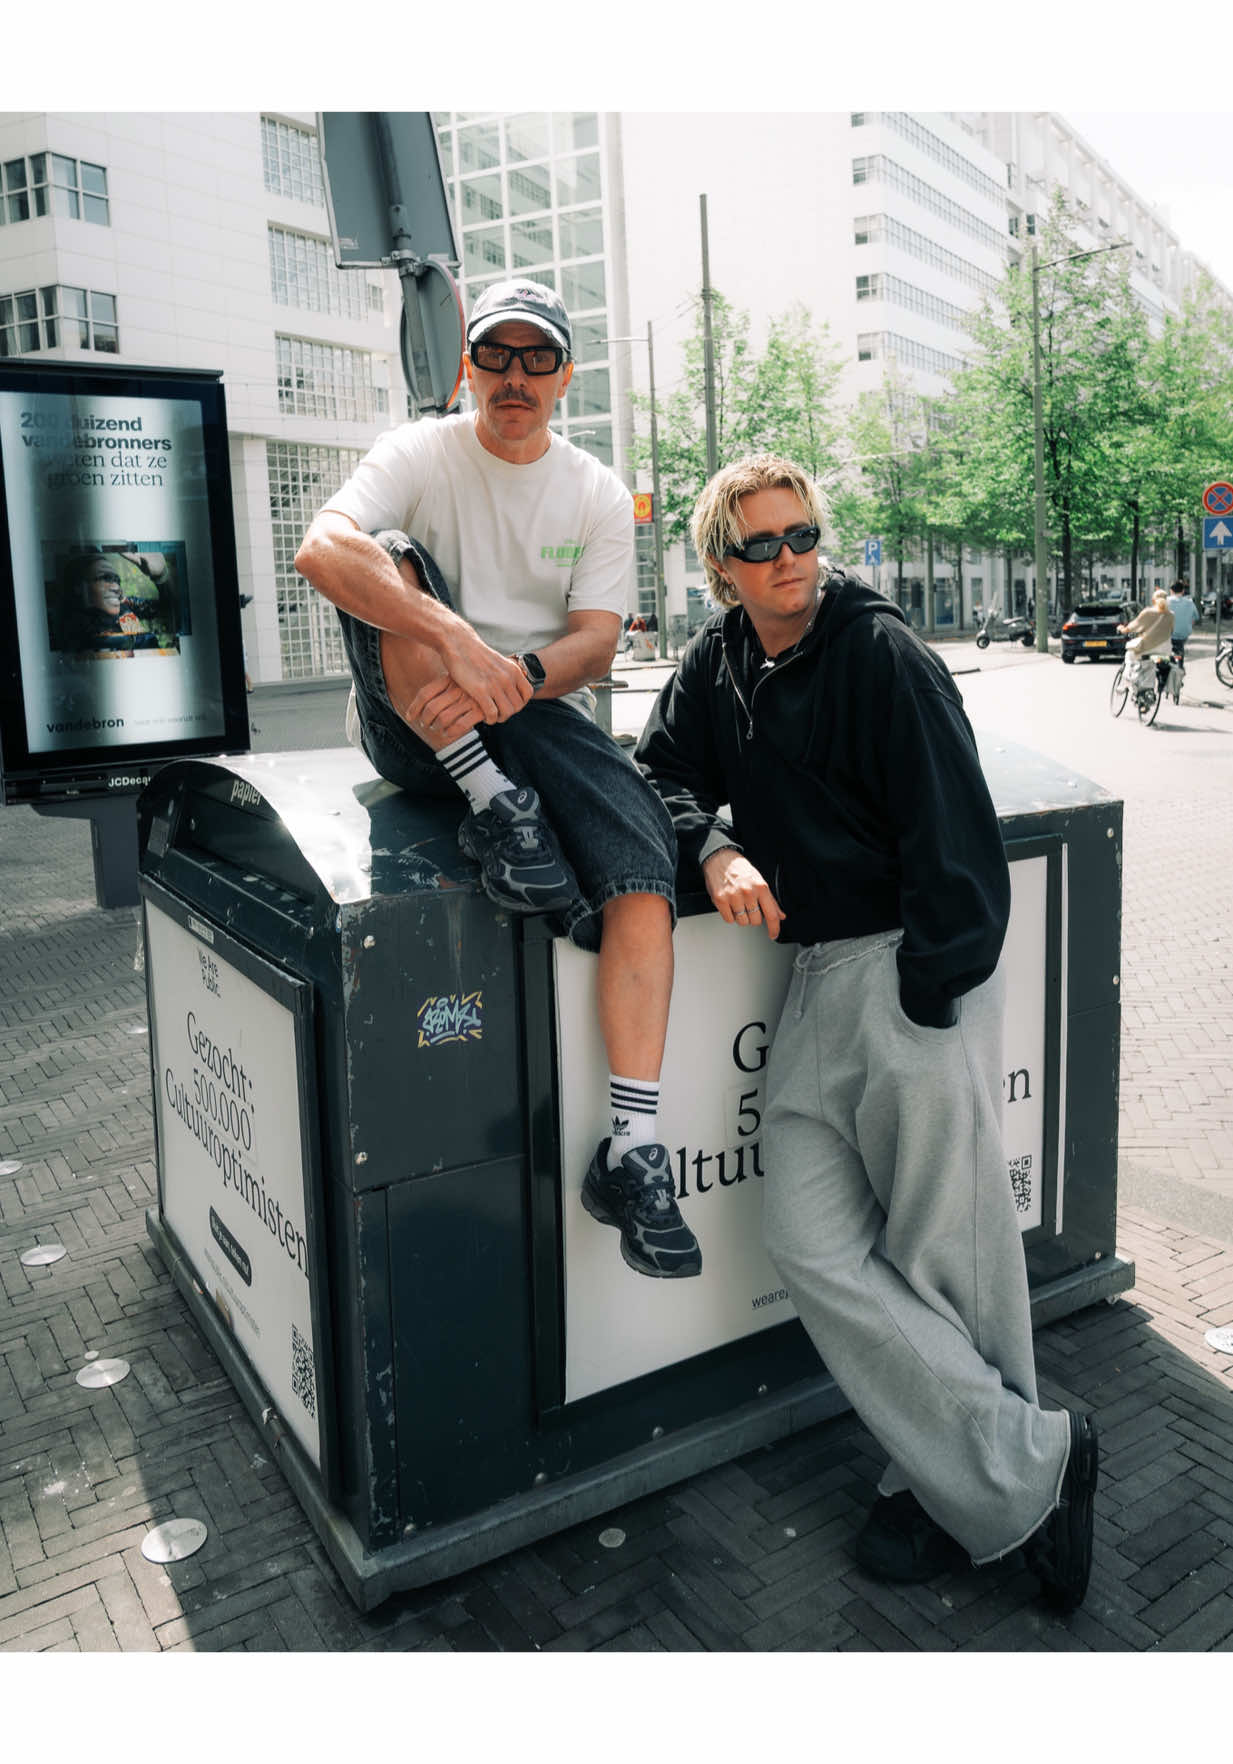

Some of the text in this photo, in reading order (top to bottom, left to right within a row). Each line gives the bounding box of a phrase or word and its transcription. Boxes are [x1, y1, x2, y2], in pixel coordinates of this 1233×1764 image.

[110, 451, 143, 468] dat
[147, 455, 168, 469] ze
[110, 470, 164, 487] zitten
[46, 717, 125, 734] vandebron
[230, 779, 261, 806] papier
[733, 1021, 769, 1073] G
[186, 1011, 255, 1112] Gezocht:
[192, 1067, 253, 1152] 500.000
[737, 1088, 761, 1137] 5
[751, 1287, 791, 1309] weare
